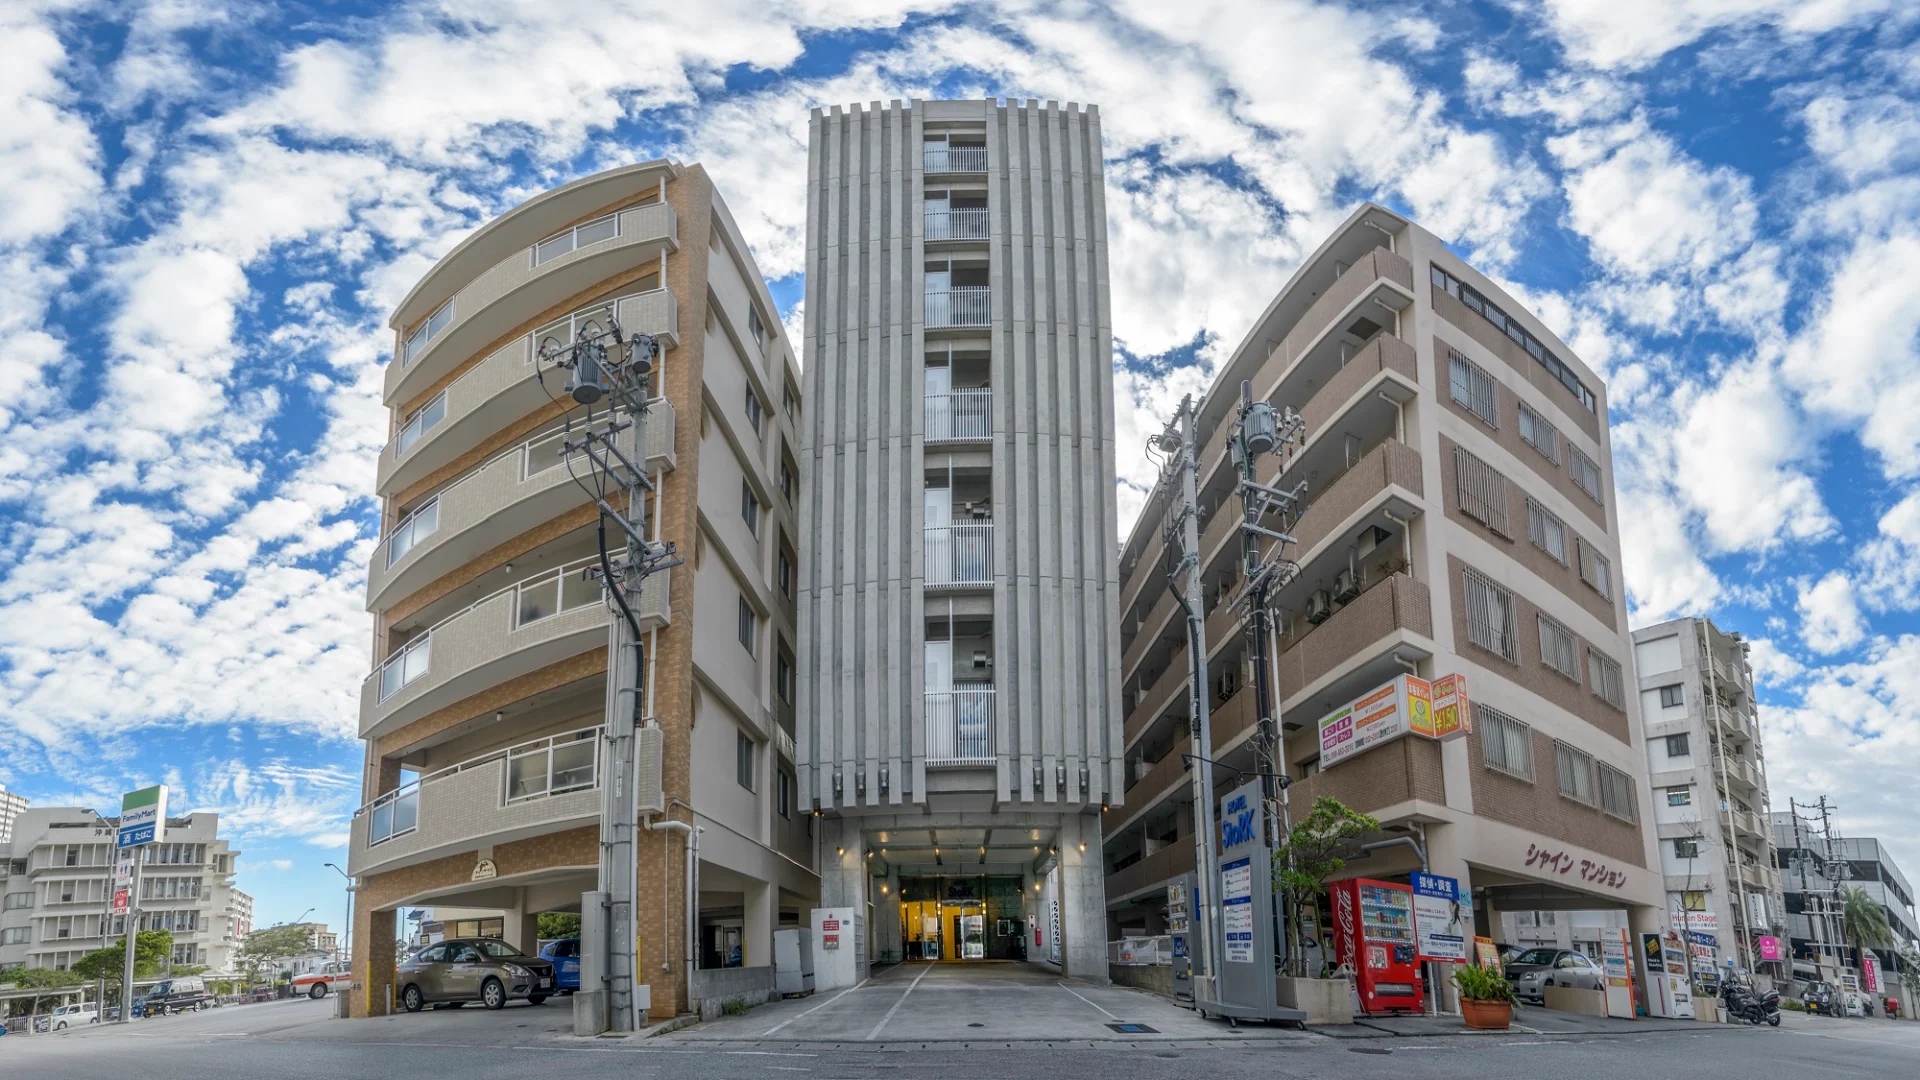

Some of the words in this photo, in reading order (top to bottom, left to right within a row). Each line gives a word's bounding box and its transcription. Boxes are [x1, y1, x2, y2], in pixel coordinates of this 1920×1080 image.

[1227, 795, 1247, 815] HOTEL
[122, 809, 156, 822] FamilyMart
[122, 833, 131, 844] 酒
[134, 830, 152, 840] たばこ
[1525, 843, 1574, 874] シャイン
[1580, 859, 1627, 889] マンション
[1419, 876, 1453, 893] 探偵・調査
[1697, 914, 1717, 922] Stage
